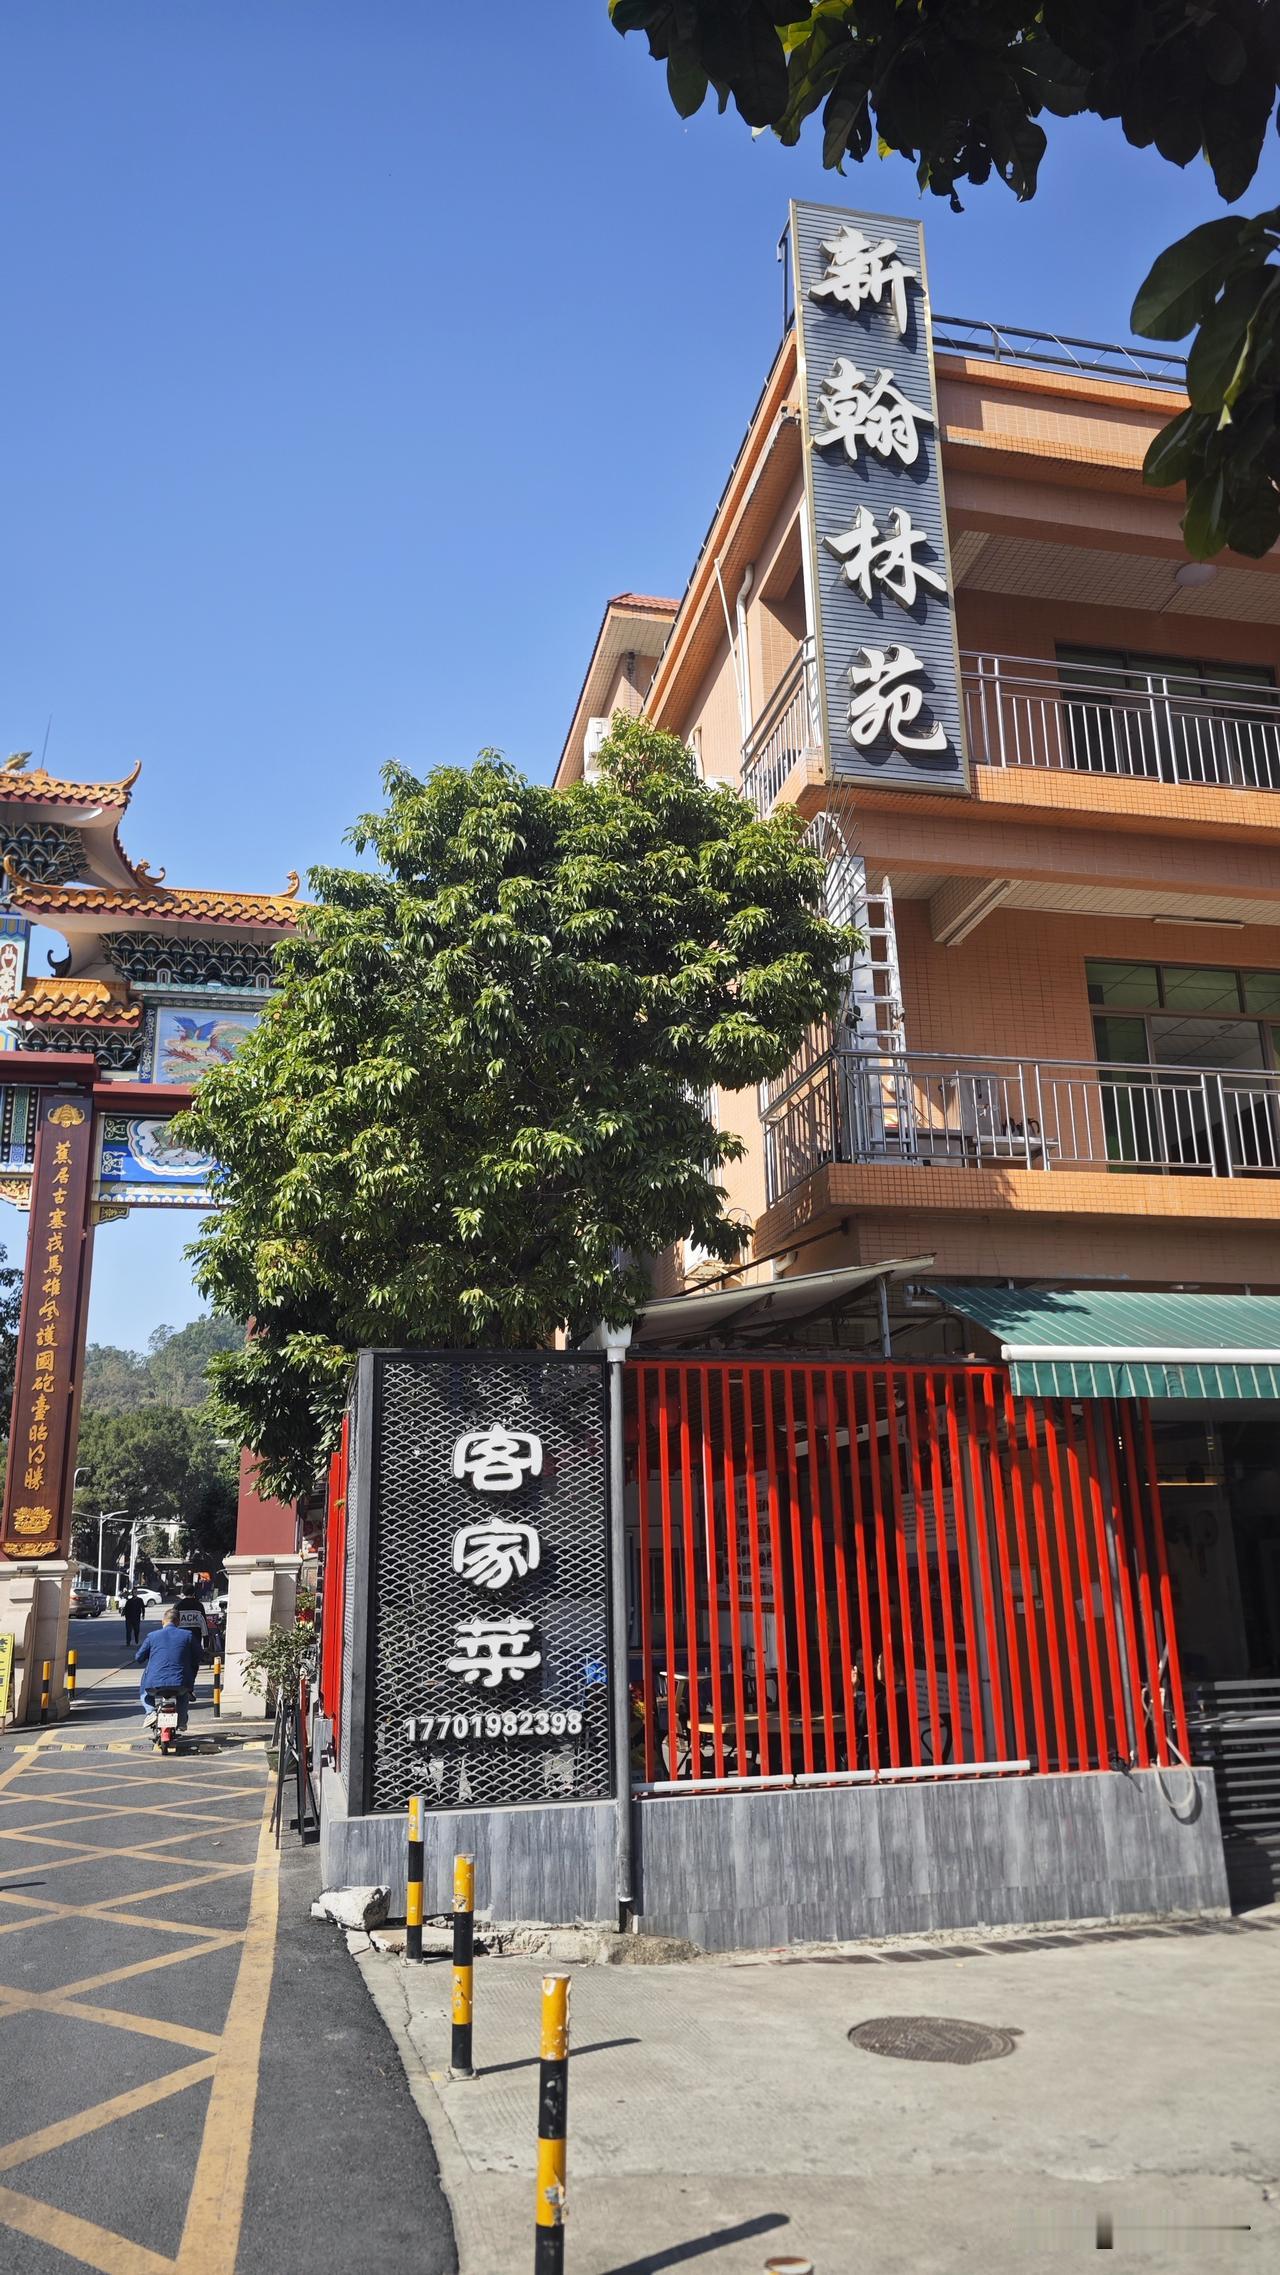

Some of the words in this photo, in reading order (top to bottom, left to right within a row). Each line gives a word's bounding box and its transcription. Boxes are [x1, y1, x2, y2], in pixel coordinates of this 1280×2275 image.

[810, 225, 948, 752] 新翰林苑
[447, 1423, 543, 1687] 客家菜
[404, 1710, 583, 1742] 17701982398
